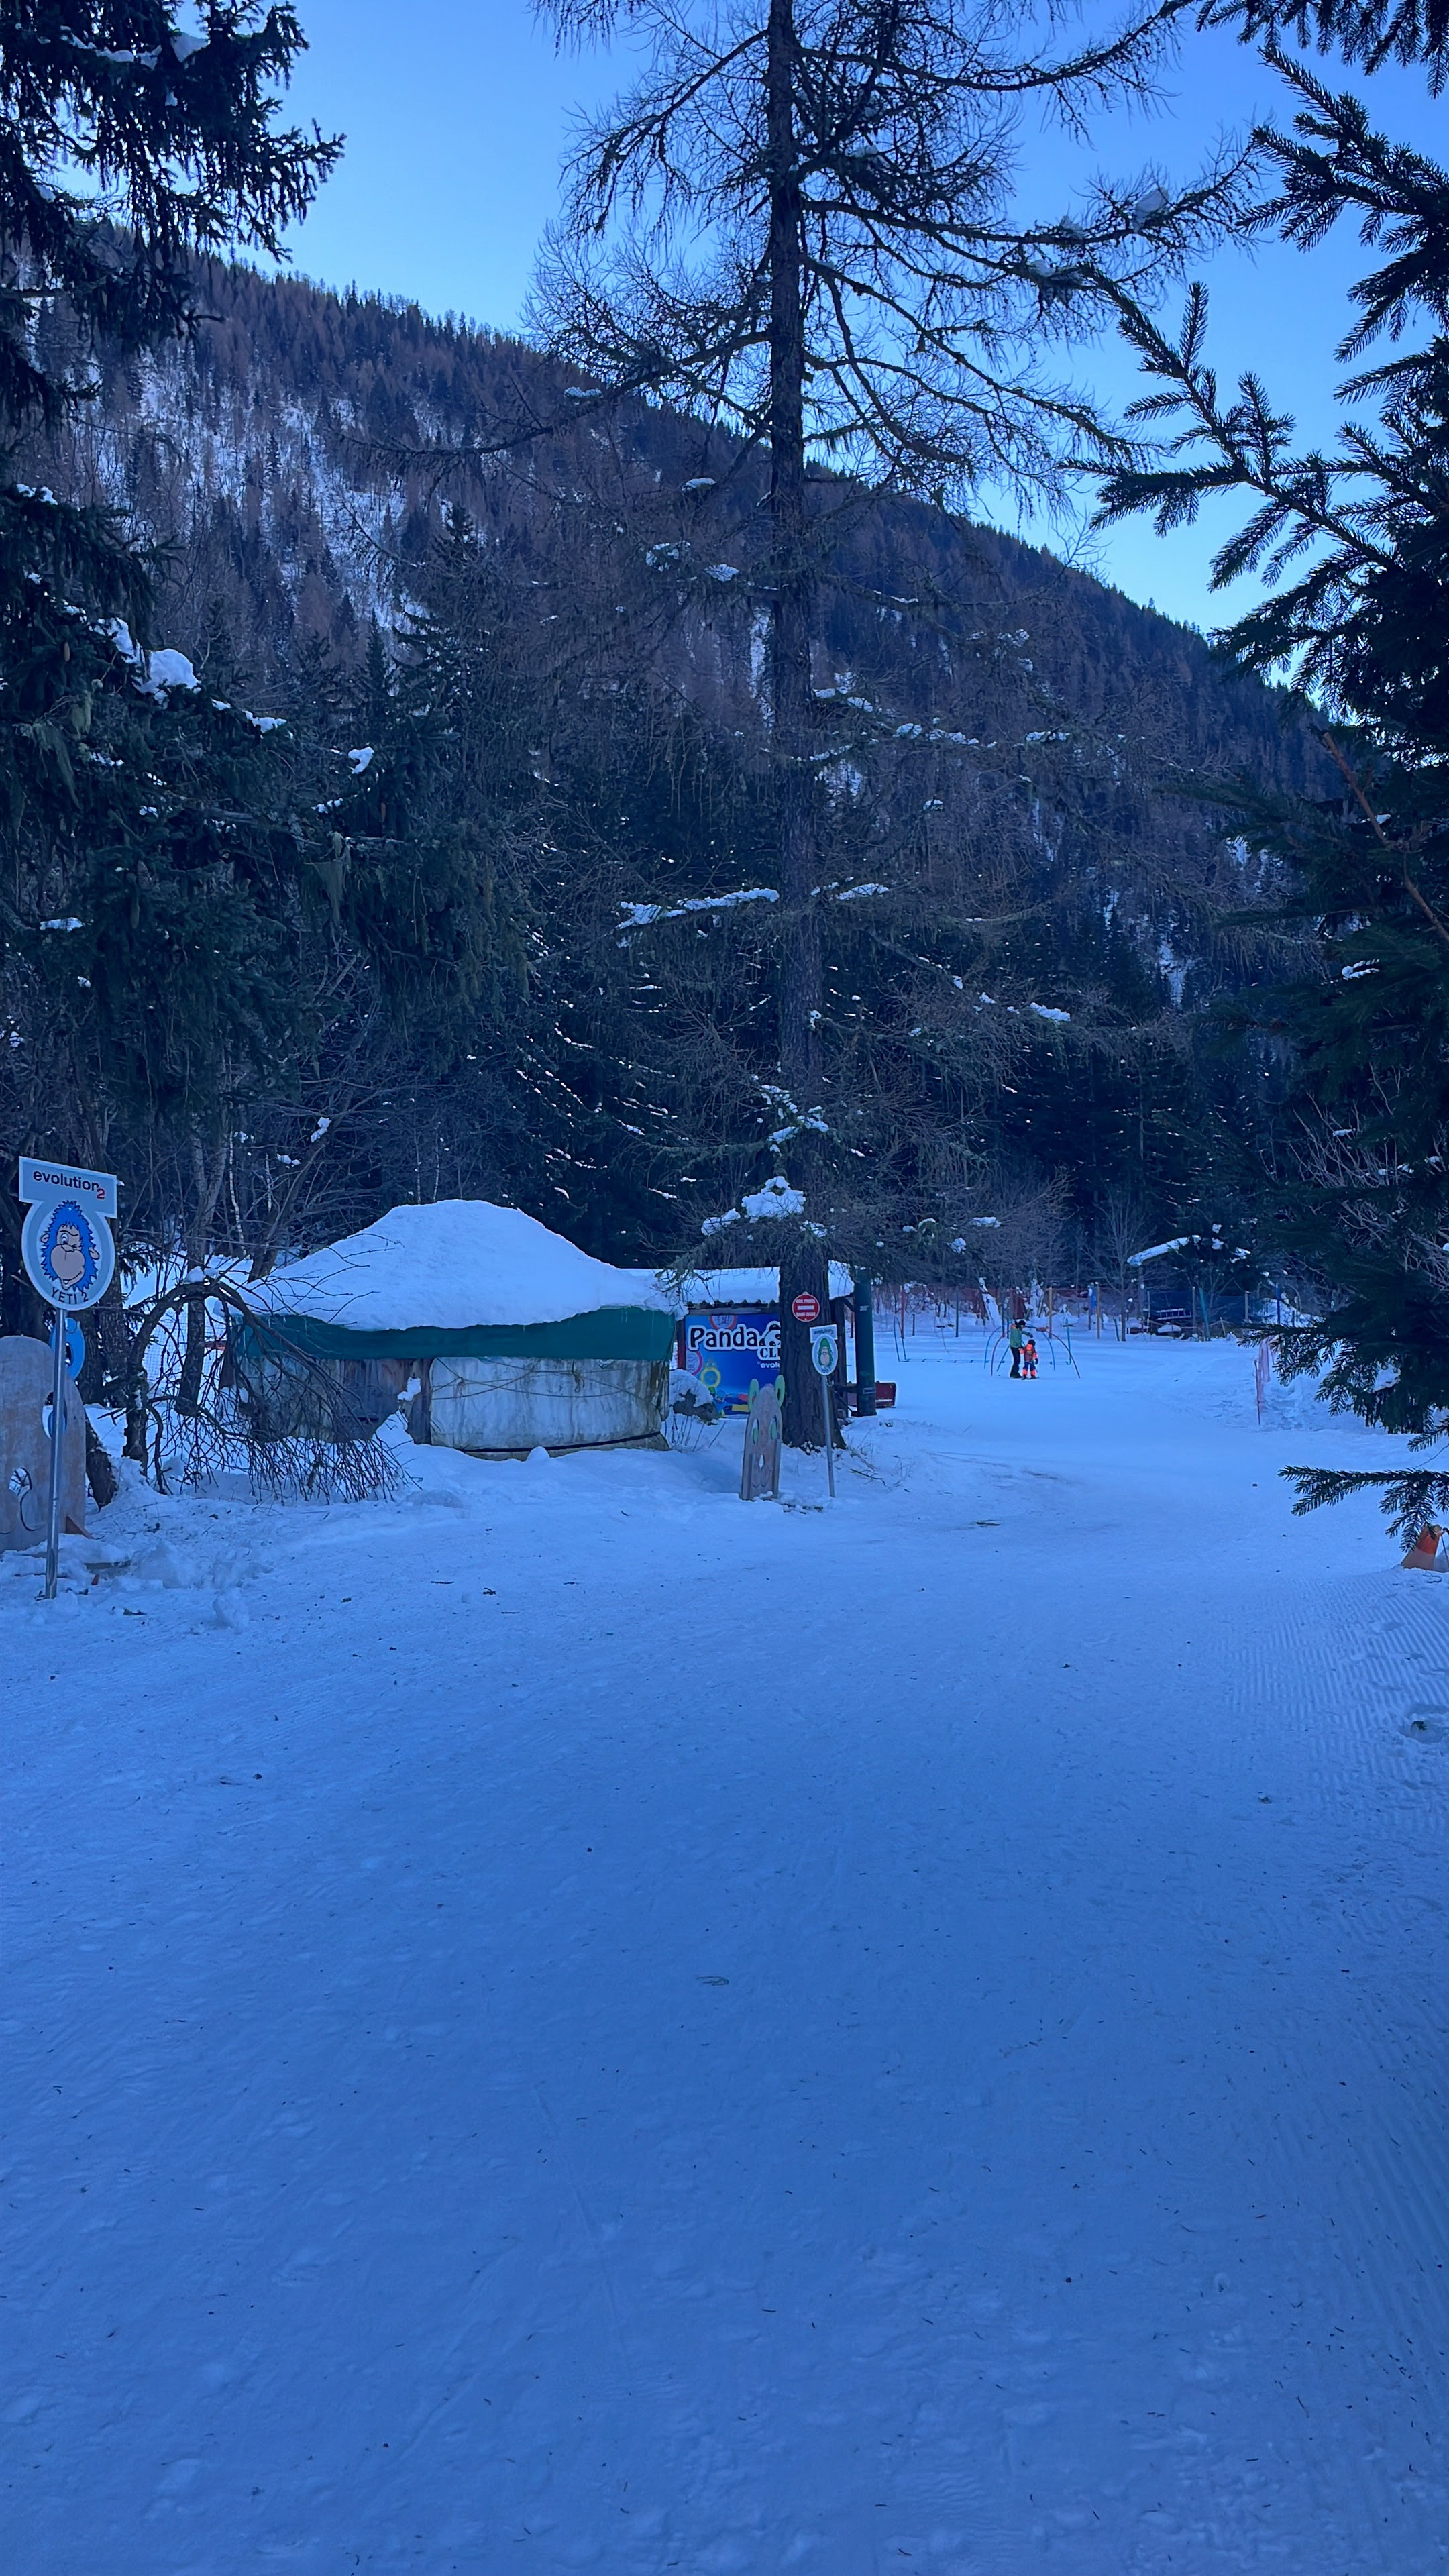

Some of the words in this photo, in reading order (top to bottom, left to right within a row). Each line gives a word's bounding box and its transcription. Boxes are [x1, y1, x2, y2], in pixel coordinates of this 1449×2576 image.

[52, 1287, 77, 1304] YETI
[81, 1291, 89, 1302] 2
[690, 1326, 759, 1348] Panda
[760, 1347, 780, 1358] CL
